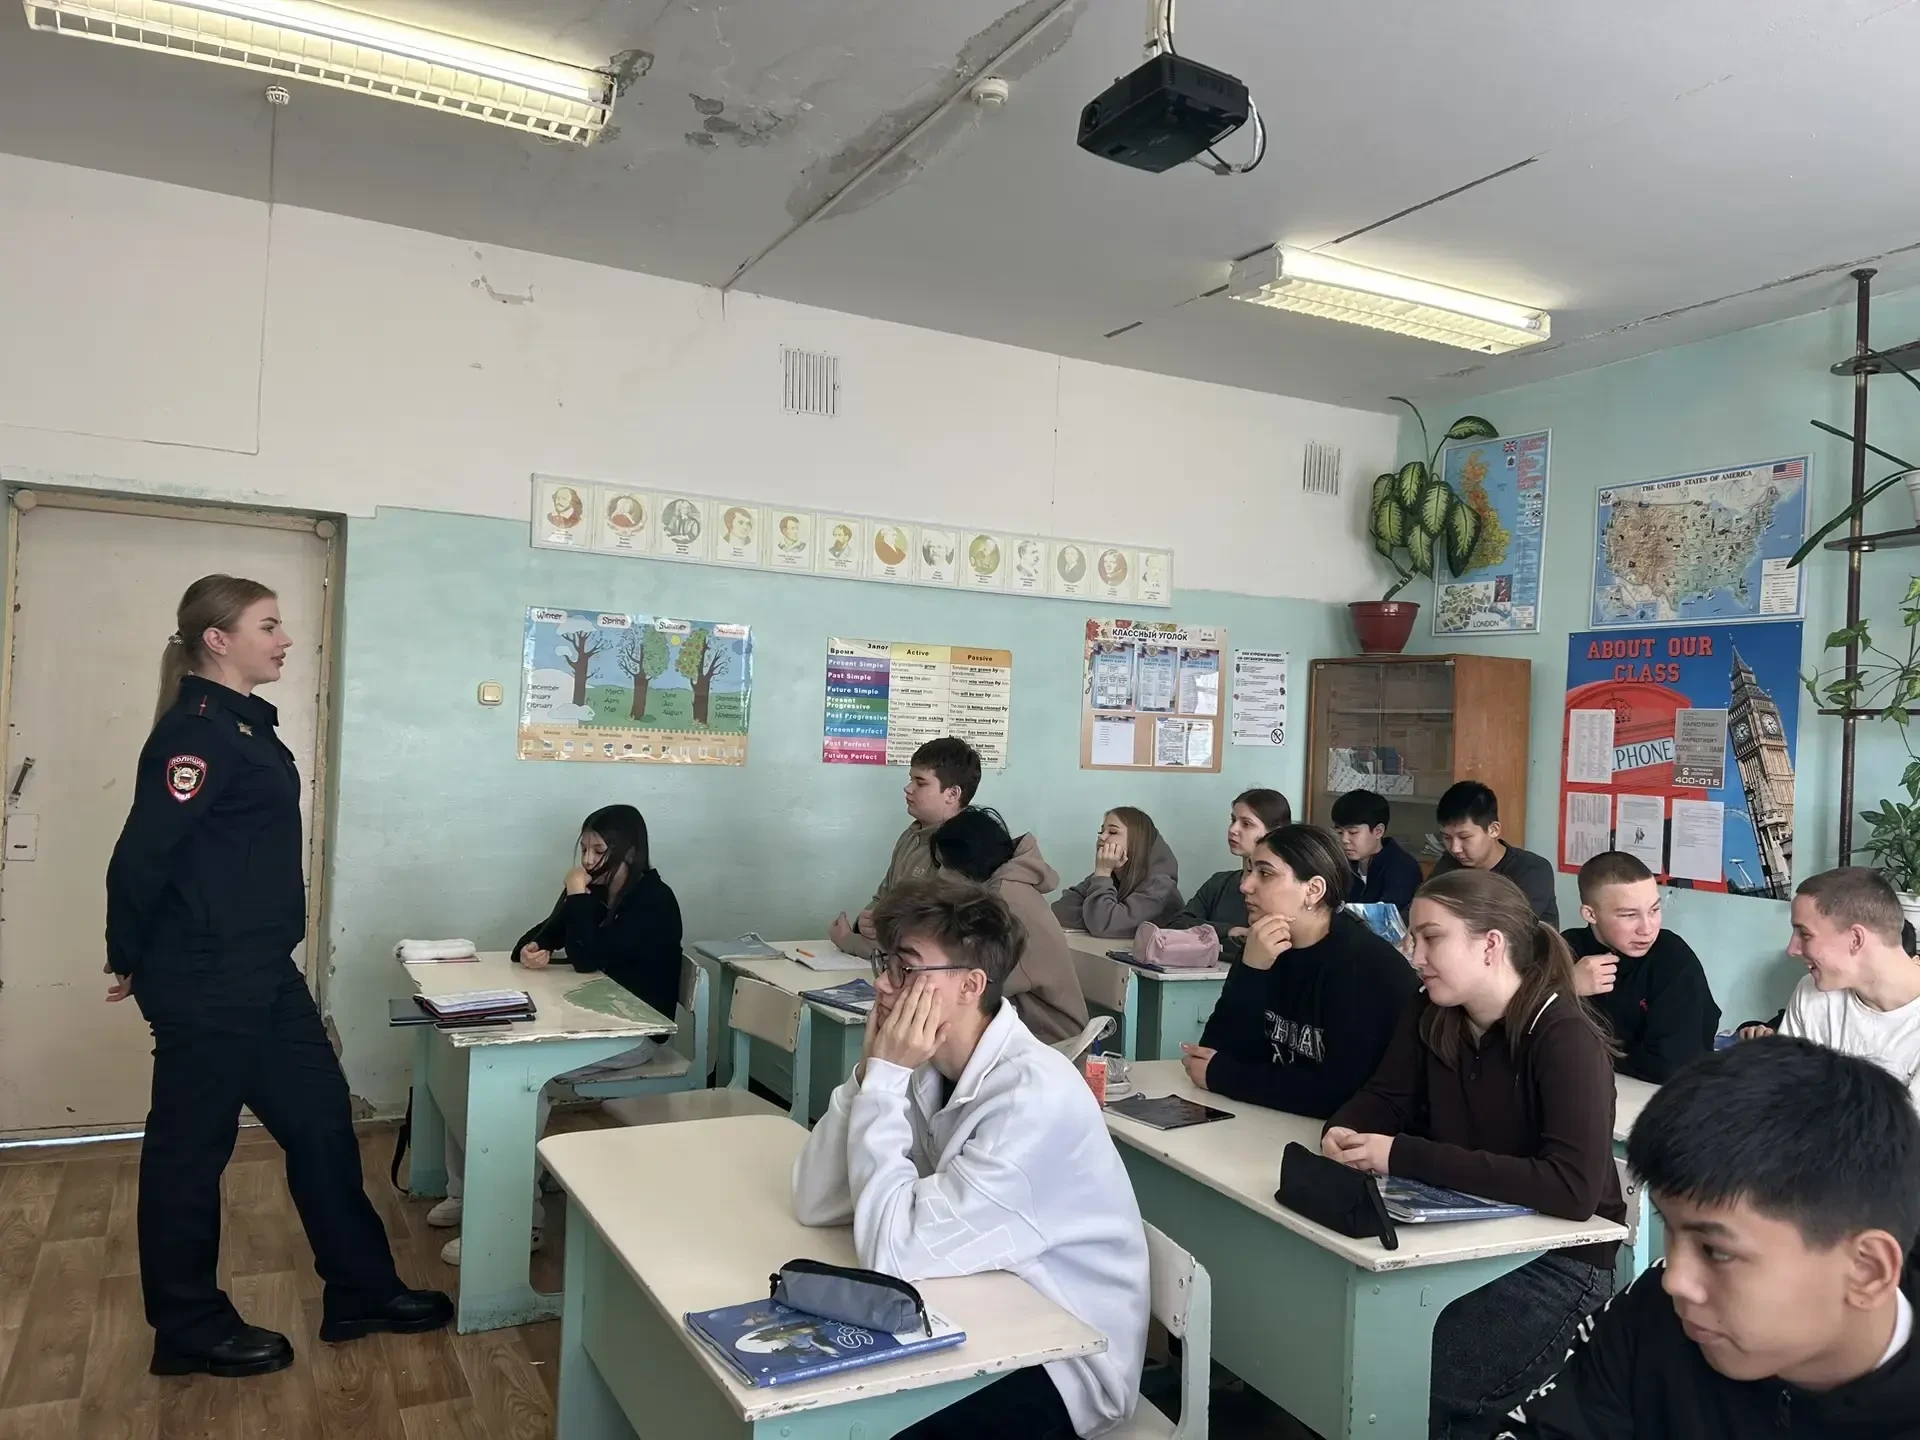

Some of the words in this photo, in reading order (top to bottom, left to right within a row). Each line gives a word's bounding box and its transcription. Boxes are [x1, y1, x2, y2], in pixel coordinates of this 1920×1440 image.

[1657, 481, 1681, 490] UNITED
[1721, 470, 1752, 480] AMERICA
[536, 610, 562, 620] Winter
[602, 617, 626, 626] Spring
[1112, 629, 1157, 638] КЛАССНЫЙ
[1159, 632, 1188, 641] УГОЛОК
[1587, 638, 1656, 660] ABOUT
[1668, 636, 1713, 657] OUR
[828, 659, 857, 667] Present
[860, 661, 884, 669] Simple
[828, 671, 844, 679] Past
[846, 673, 871, 681] Simple
[1614, 663, 1680, 683] CLASS
[854, 687, 879, 695] Simple
[826, 702, 871, 710] Progressive
[1612, 740, 1673, 770] PHONE
[171, 756, 205, 769] ПОЛИЦИЯ
[1675, 776, 1720, 786] 400-015
